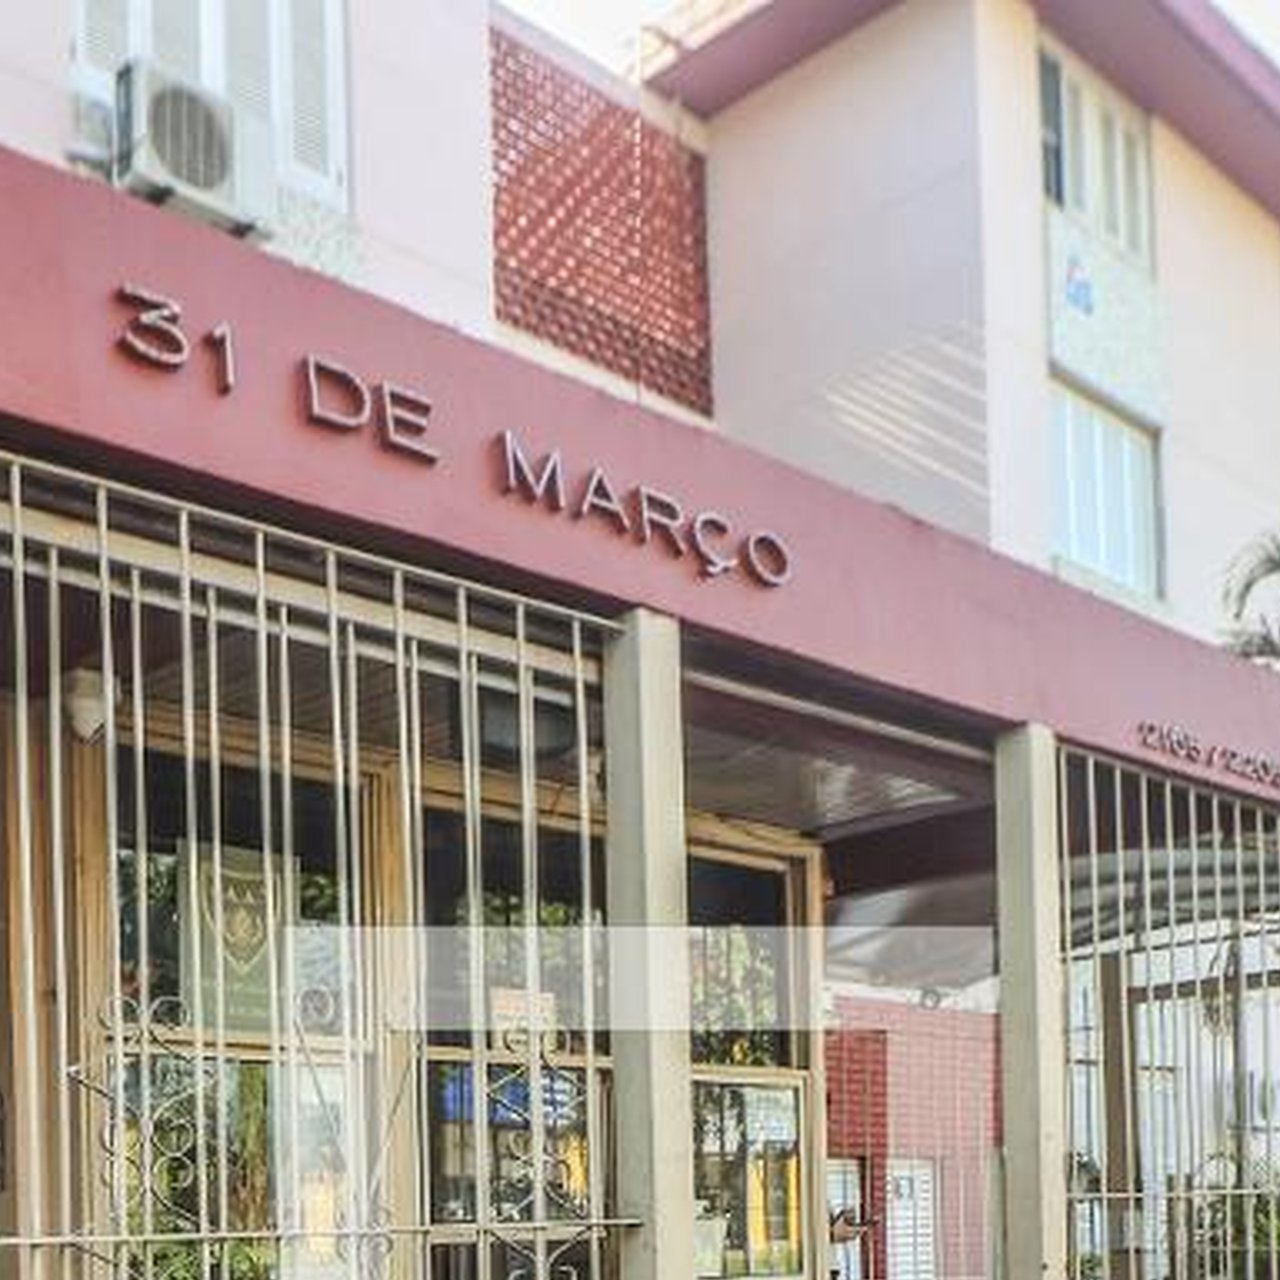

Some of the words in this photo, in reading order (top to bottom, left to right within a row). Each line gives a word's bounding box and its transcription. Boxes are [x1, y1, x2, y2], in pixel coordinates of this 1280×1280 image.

[116, 281, 236, 396] 31
[296, 352, 440, 467] DE
[494, 428, 793, 589] MARÇO
